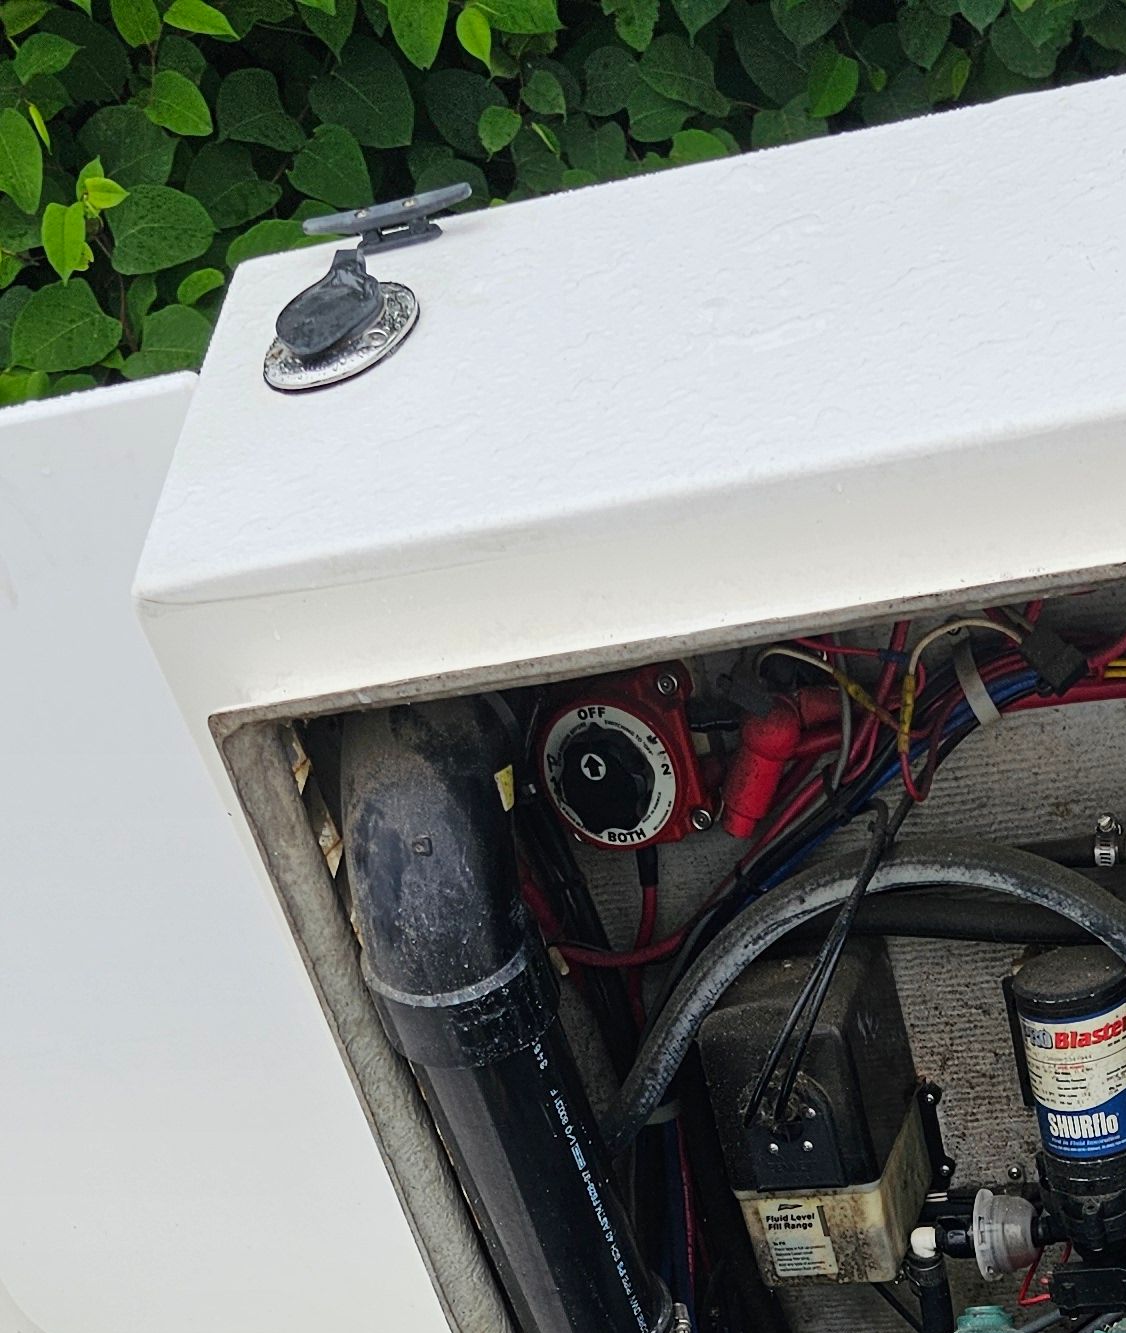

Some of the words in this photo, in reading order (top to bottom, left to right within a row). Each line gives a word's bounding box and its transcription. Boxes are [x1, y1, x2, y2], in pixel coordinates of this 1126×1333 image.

[577, 706, 606, 720] OFF
[661, 763, 672, 776] 2
[607, 827, 646, 843] BOTH
[1047, 1111, 1119, 1139] SHURflo
[766, 1214, 789, 1223] Fluid
[790, 1213, 815, 1221] Level
[768, 1222, 782, 1231] Fill
[784, 1222, 813, 1230] Range
